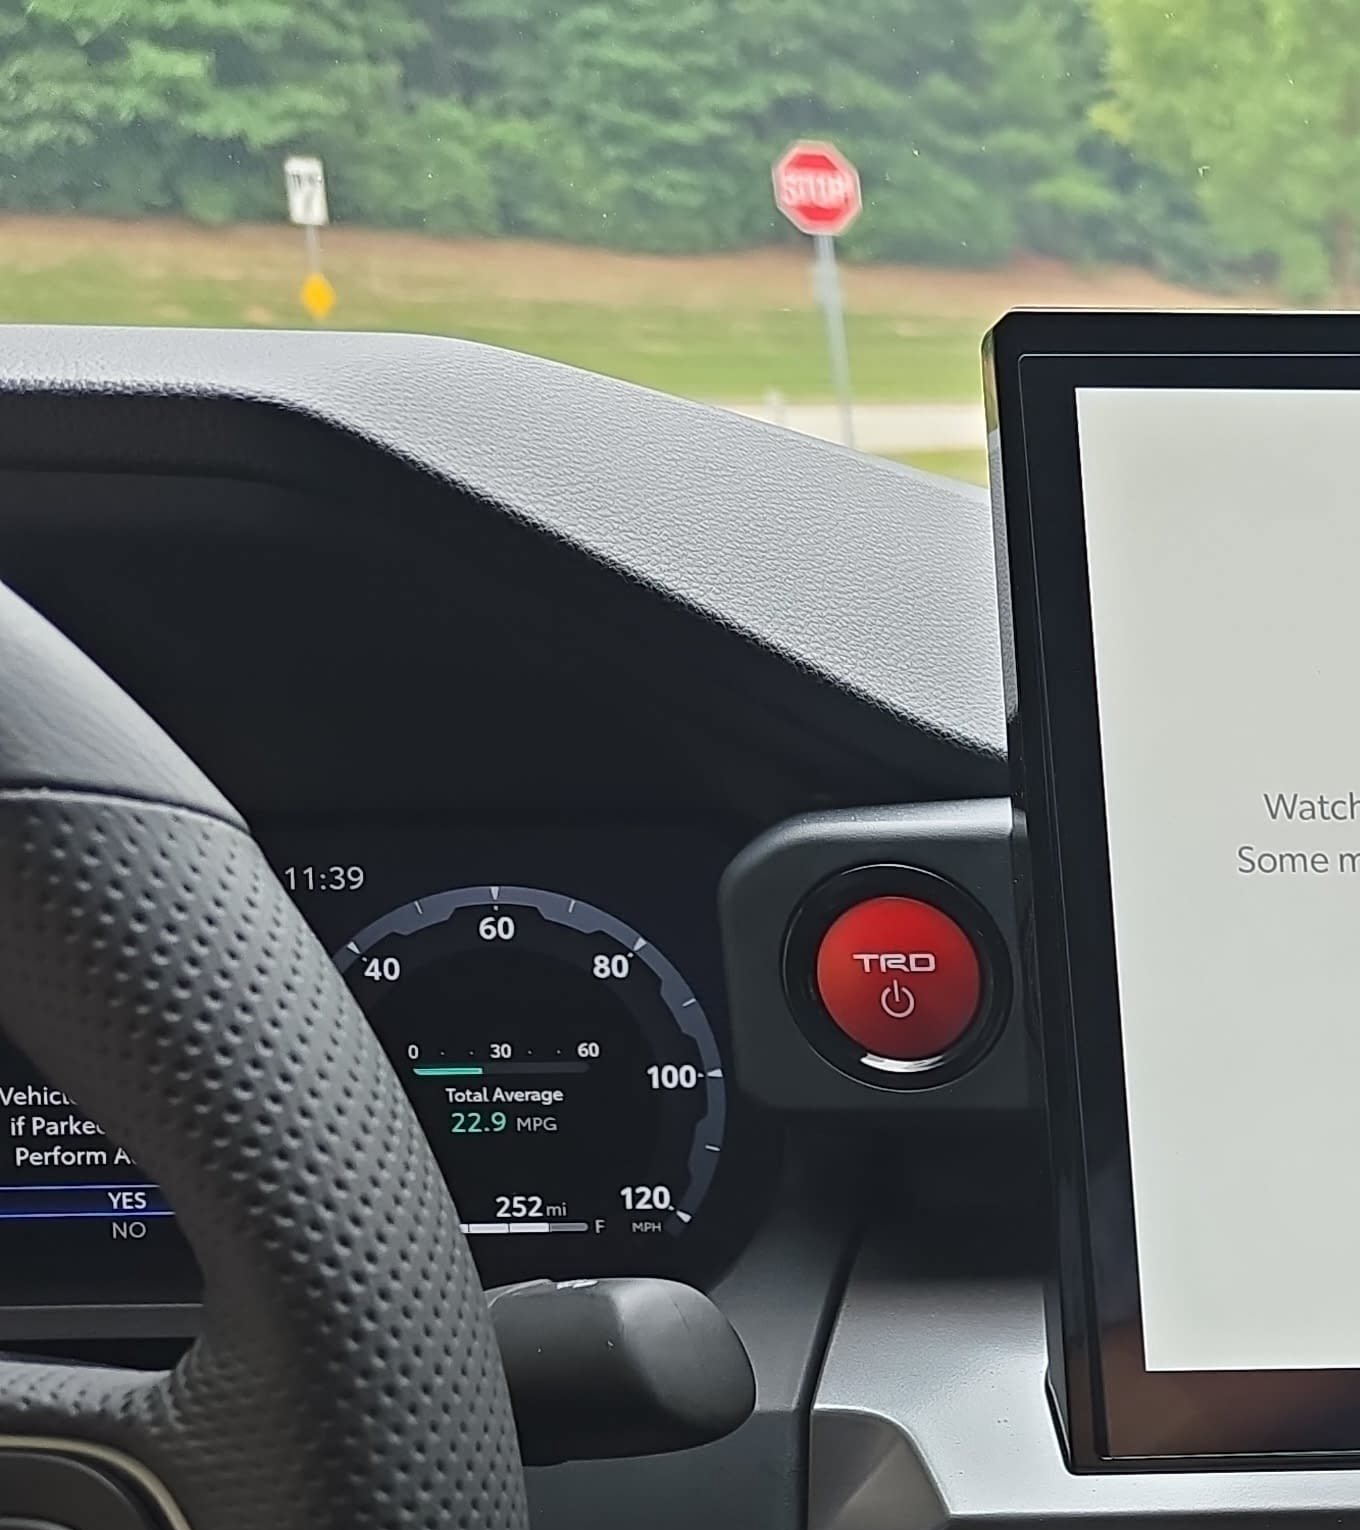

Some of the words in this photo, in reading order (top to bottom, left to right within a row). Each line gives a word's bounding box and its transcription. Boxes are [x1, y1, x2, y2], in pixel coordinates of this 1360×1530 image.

[1238, 845, 1329, 874] Some
[285, 866, 364, 890] 11:39
[478, 916, 515, 940] 60
[364, 957, 400, 981] 40
[592, 954, 629, 979] 80
[852, 953, 937, 974] TRD
[407, 1044, 419, 1060] 0
[489, 1043, 512, 1059] 30
[577, 1042, 600, 1058] 60
[647, 1064, 697, 1089] 100
[445, 1087, 487, 1103] Total
[490, 1086, 564, 1105] Average
[10, 1117, 25, 1137] if
[451, 1111, 507, 1133] 22.9
[516, 1116, 558, 1132] MPG
[15, 1146, 107, 1167] Perform
[113, 1147, 137, 1166] A
[108, 1191, 147, 1210] YES
[495, 1196, 543, 1218] 252
[546, 1201, 568, 1217] mi
[620, 1185, 670, 1210] 120
[112, 1221, 147, 1239] NO
[595, 1219, 606, 1234] F
[632, 1221, 662, 1233] MPH
